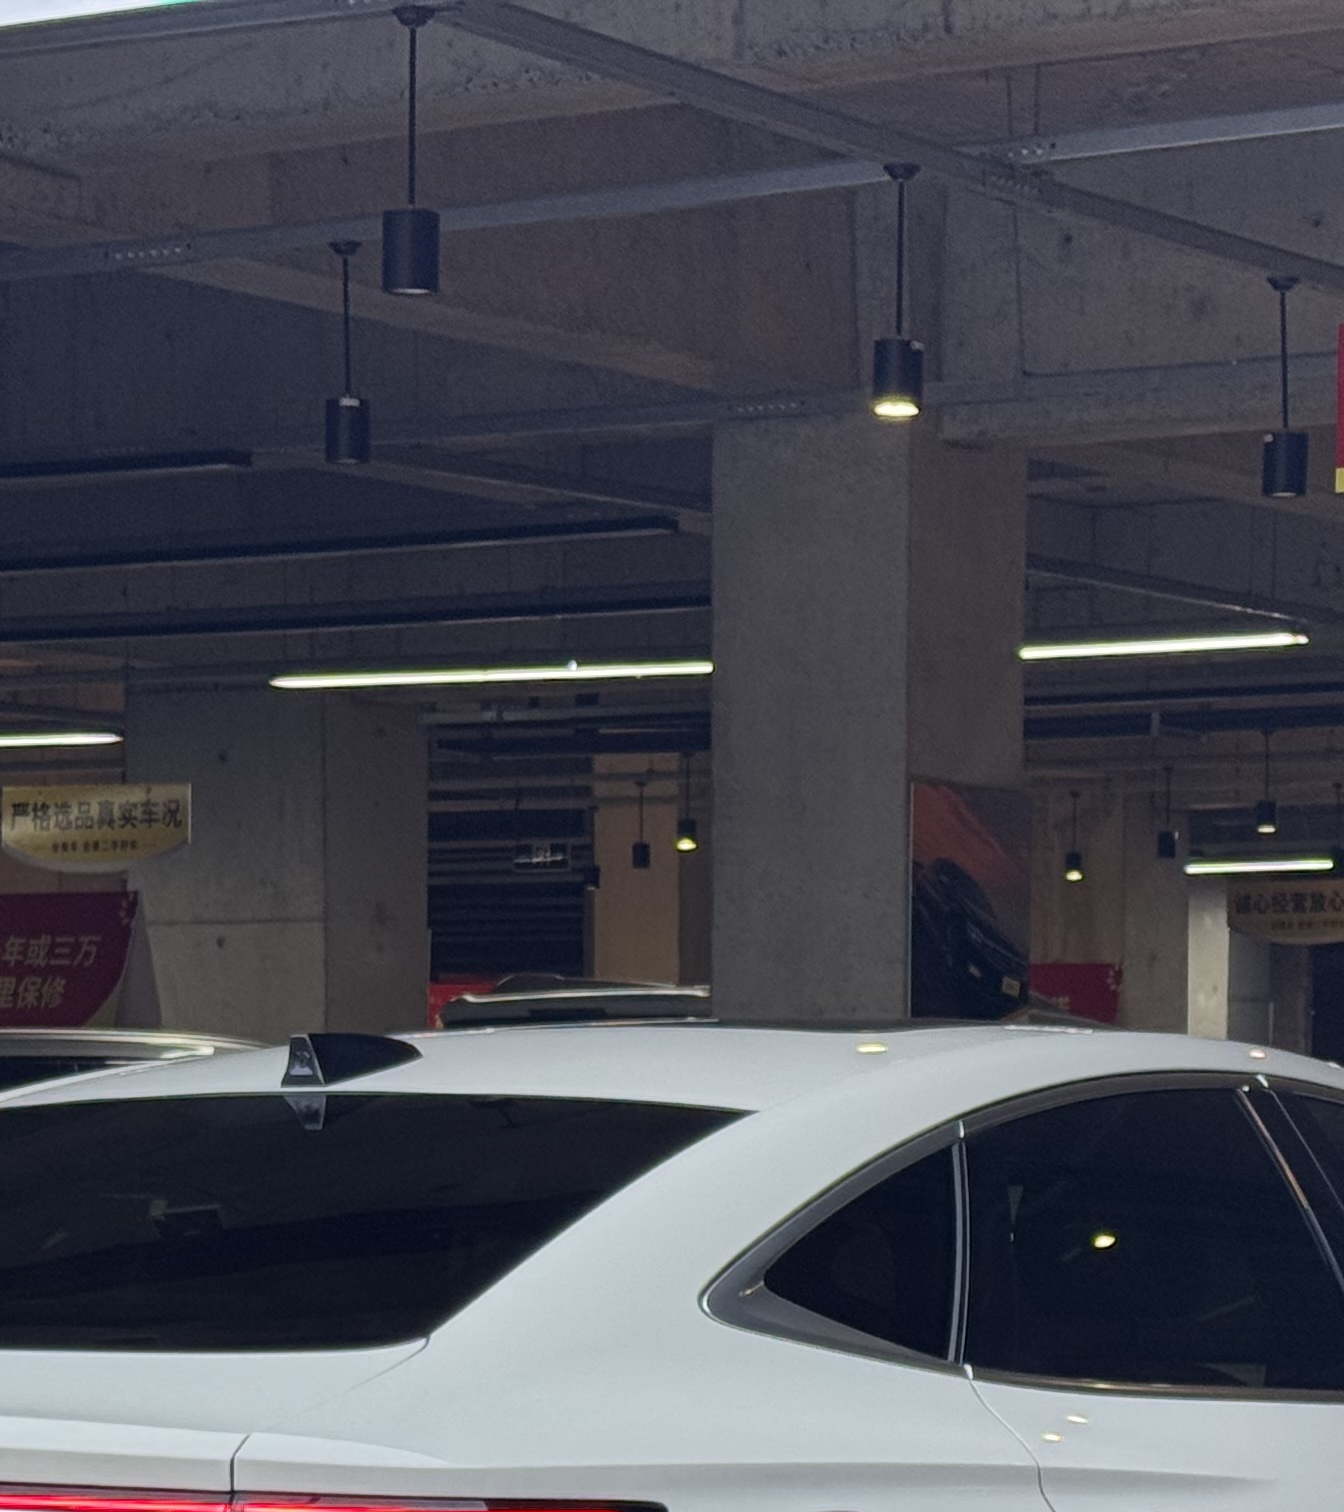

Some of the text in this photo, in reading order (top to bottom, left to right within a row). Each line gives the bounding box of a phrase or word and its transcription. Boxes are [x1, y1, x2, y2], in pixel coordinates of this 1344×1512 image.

[10, 800, 183, 831] 严格选品真实车况
